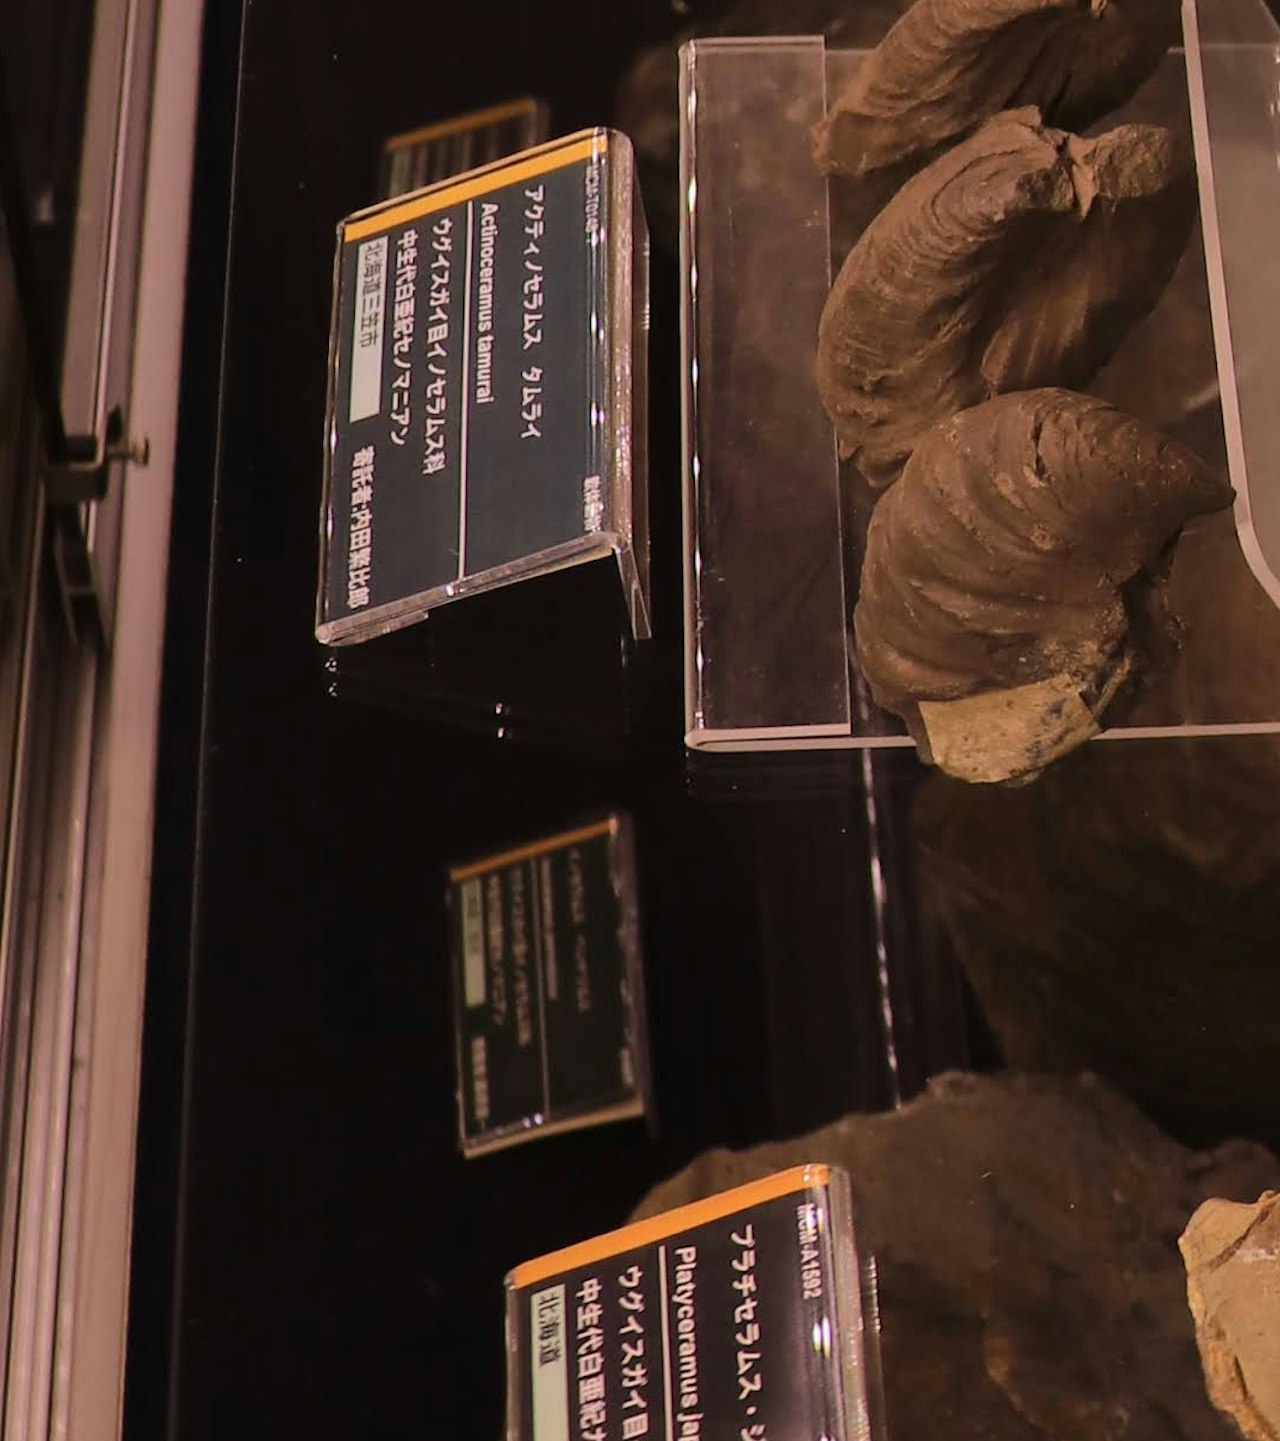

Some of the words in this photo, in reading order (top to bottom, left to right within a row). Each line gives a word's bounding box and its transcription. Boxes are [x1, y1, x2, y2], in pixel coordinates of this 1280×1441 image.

[391, 229, 415, 448] 中生代白亜紀セノマニアン
[478, 201, 496, 333] Actinoceramus
[523, 184, 543, 351] アクティノセラムス
[423, 216, 450, 475] ウグイスガイ目イノセラムス科
[478, 335, 493, 406] tamurai
[520, 365, 542, 442] タムライ
[534, 1291, 562, 1368] 北海道
[671, 1245, 701, 1409] Platyceramus
